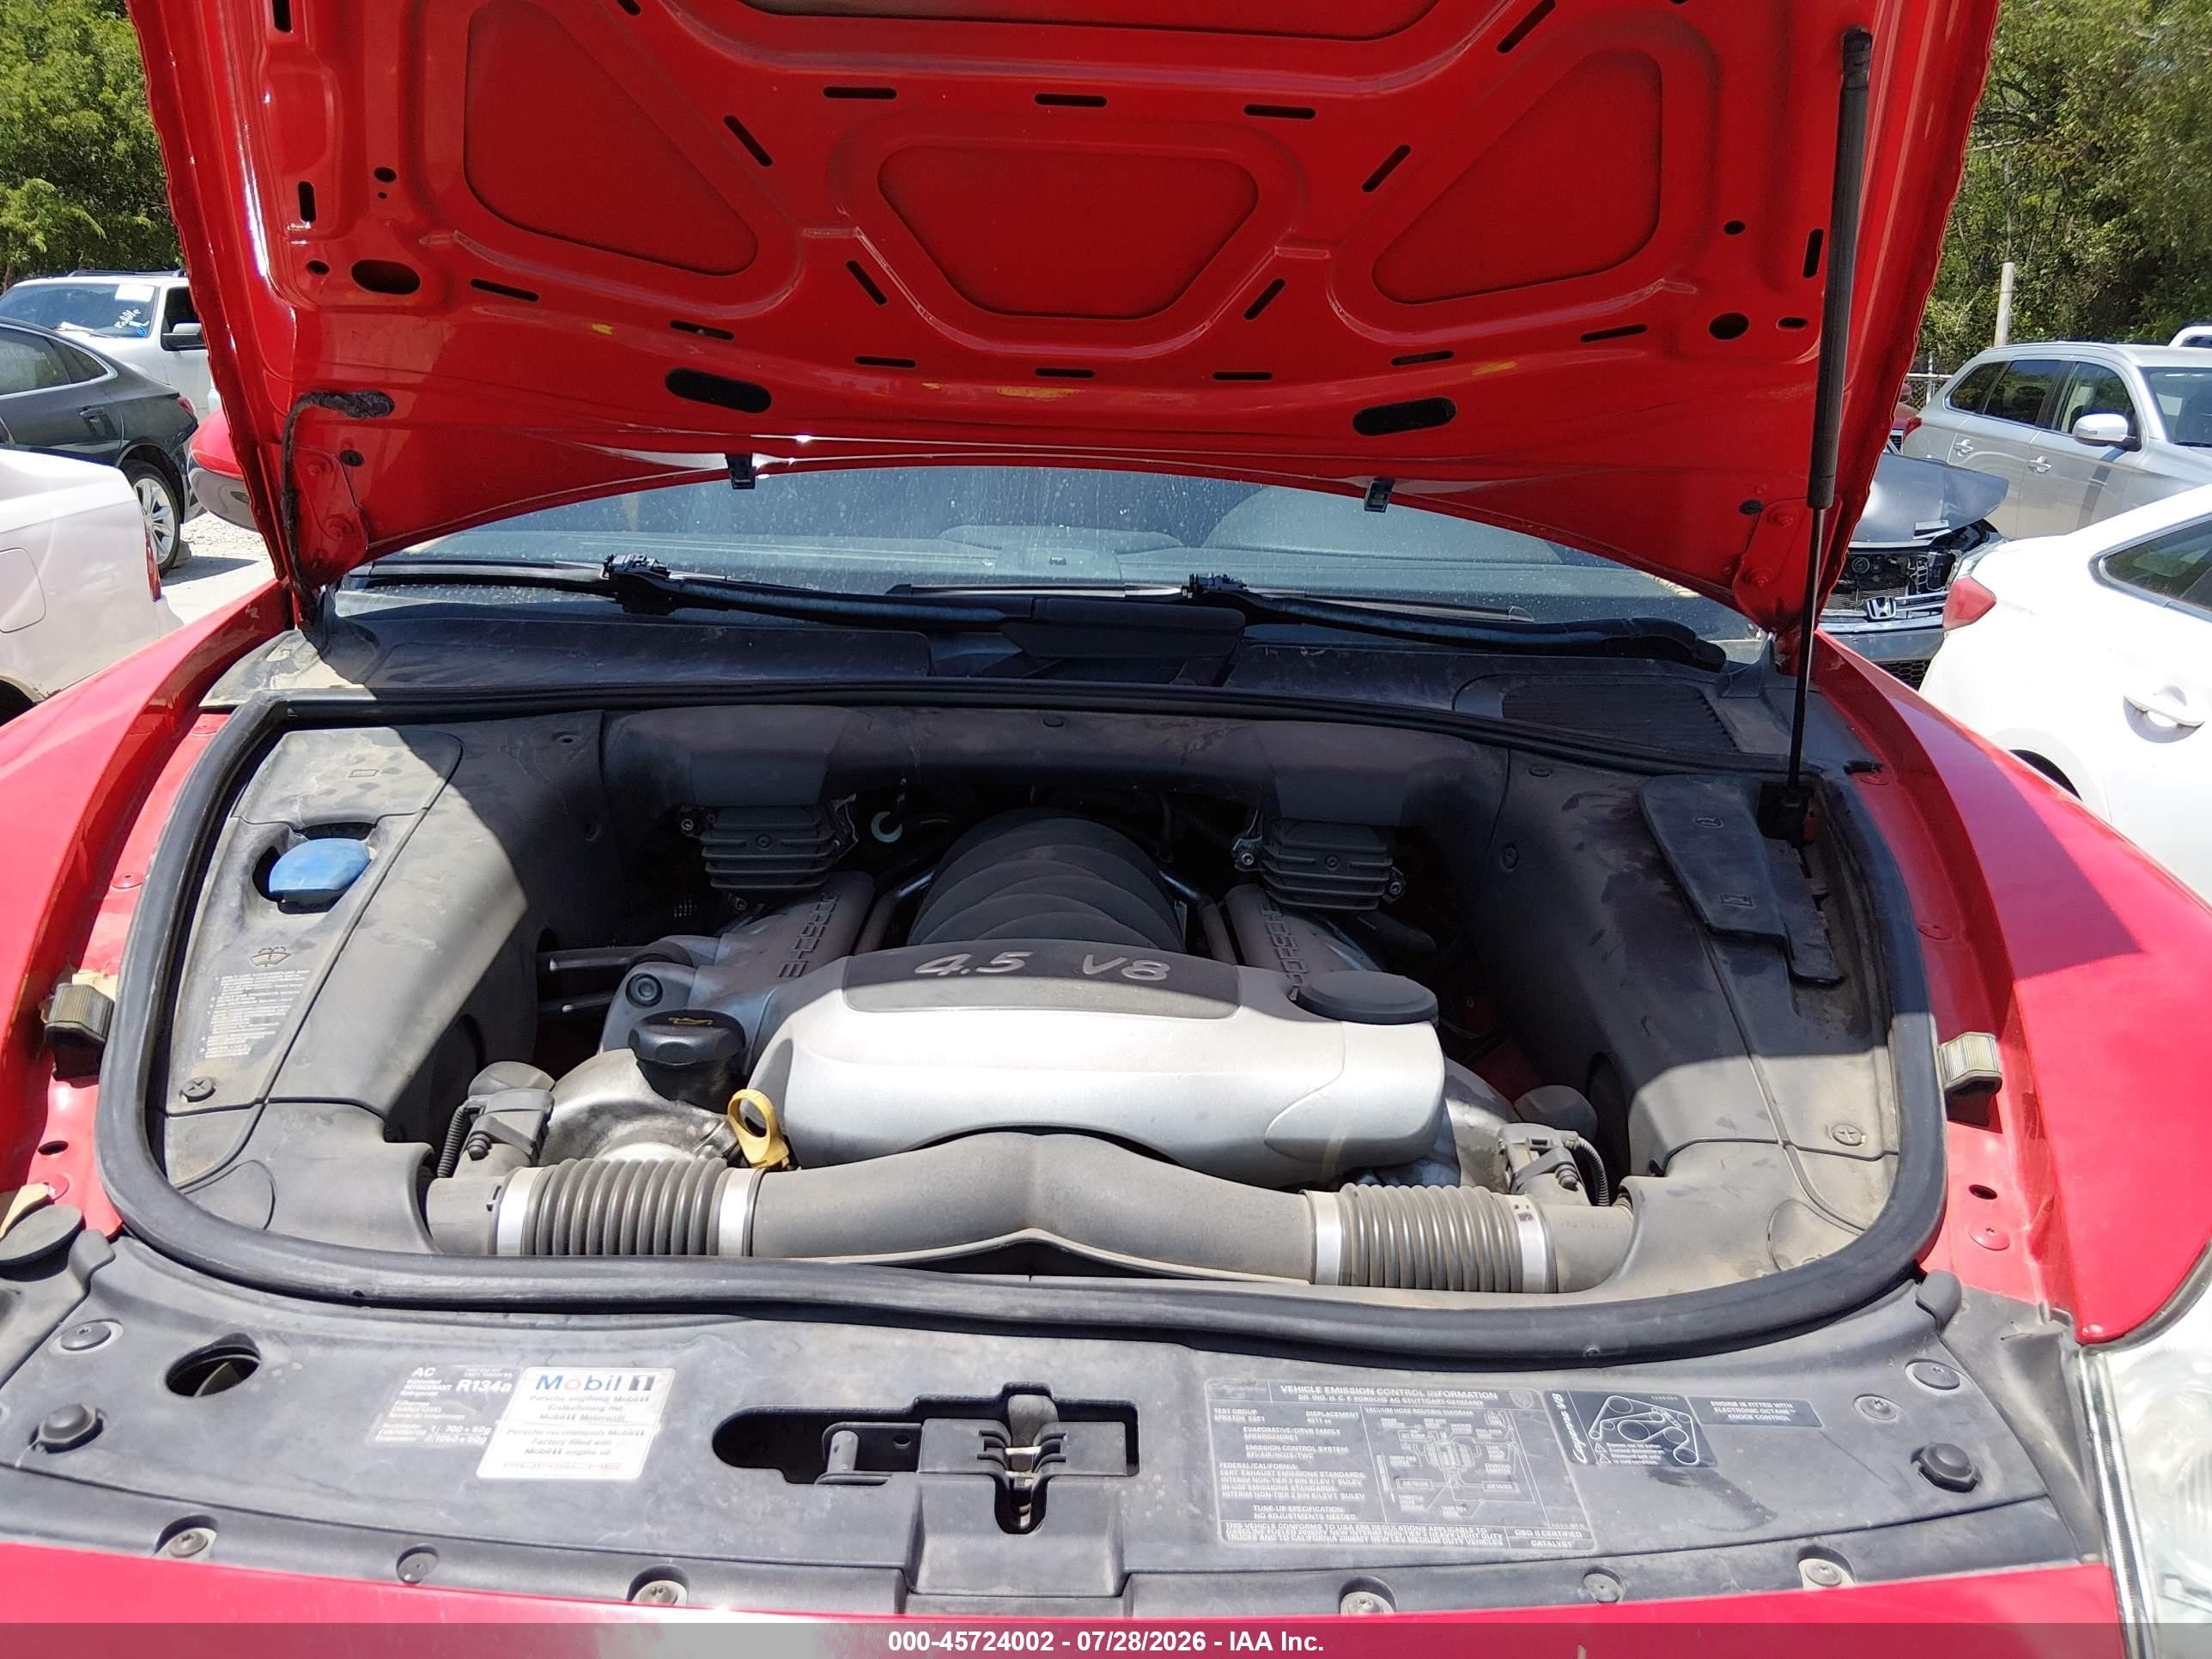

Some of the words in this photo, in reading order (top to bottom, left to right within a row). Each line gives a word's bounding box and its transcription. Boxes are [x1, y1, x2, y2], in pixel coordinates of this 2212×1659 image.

[915, 951, 1034, 976] 4.5
[1083, 955, 1170, 981] V8
[412, 1367, 436, 1376] AC
[456, 1379, 513, 1393] R134a
[535, 1375, 623, 1391] Mobil
[629, 1376, 656, 1391] 1
[1280, 1385, 1322, 1395] VEHICLE
[1325, 1387, 1374, 1396] EMISSION
[1376, 1389, 1425, 1397] CONTROL
[1427, 1390, 1498, 1400] INFORMATION
[1552, 1393, 1566, 1410] V8
[1561, 1411, 1587, 1463] Cayenne
